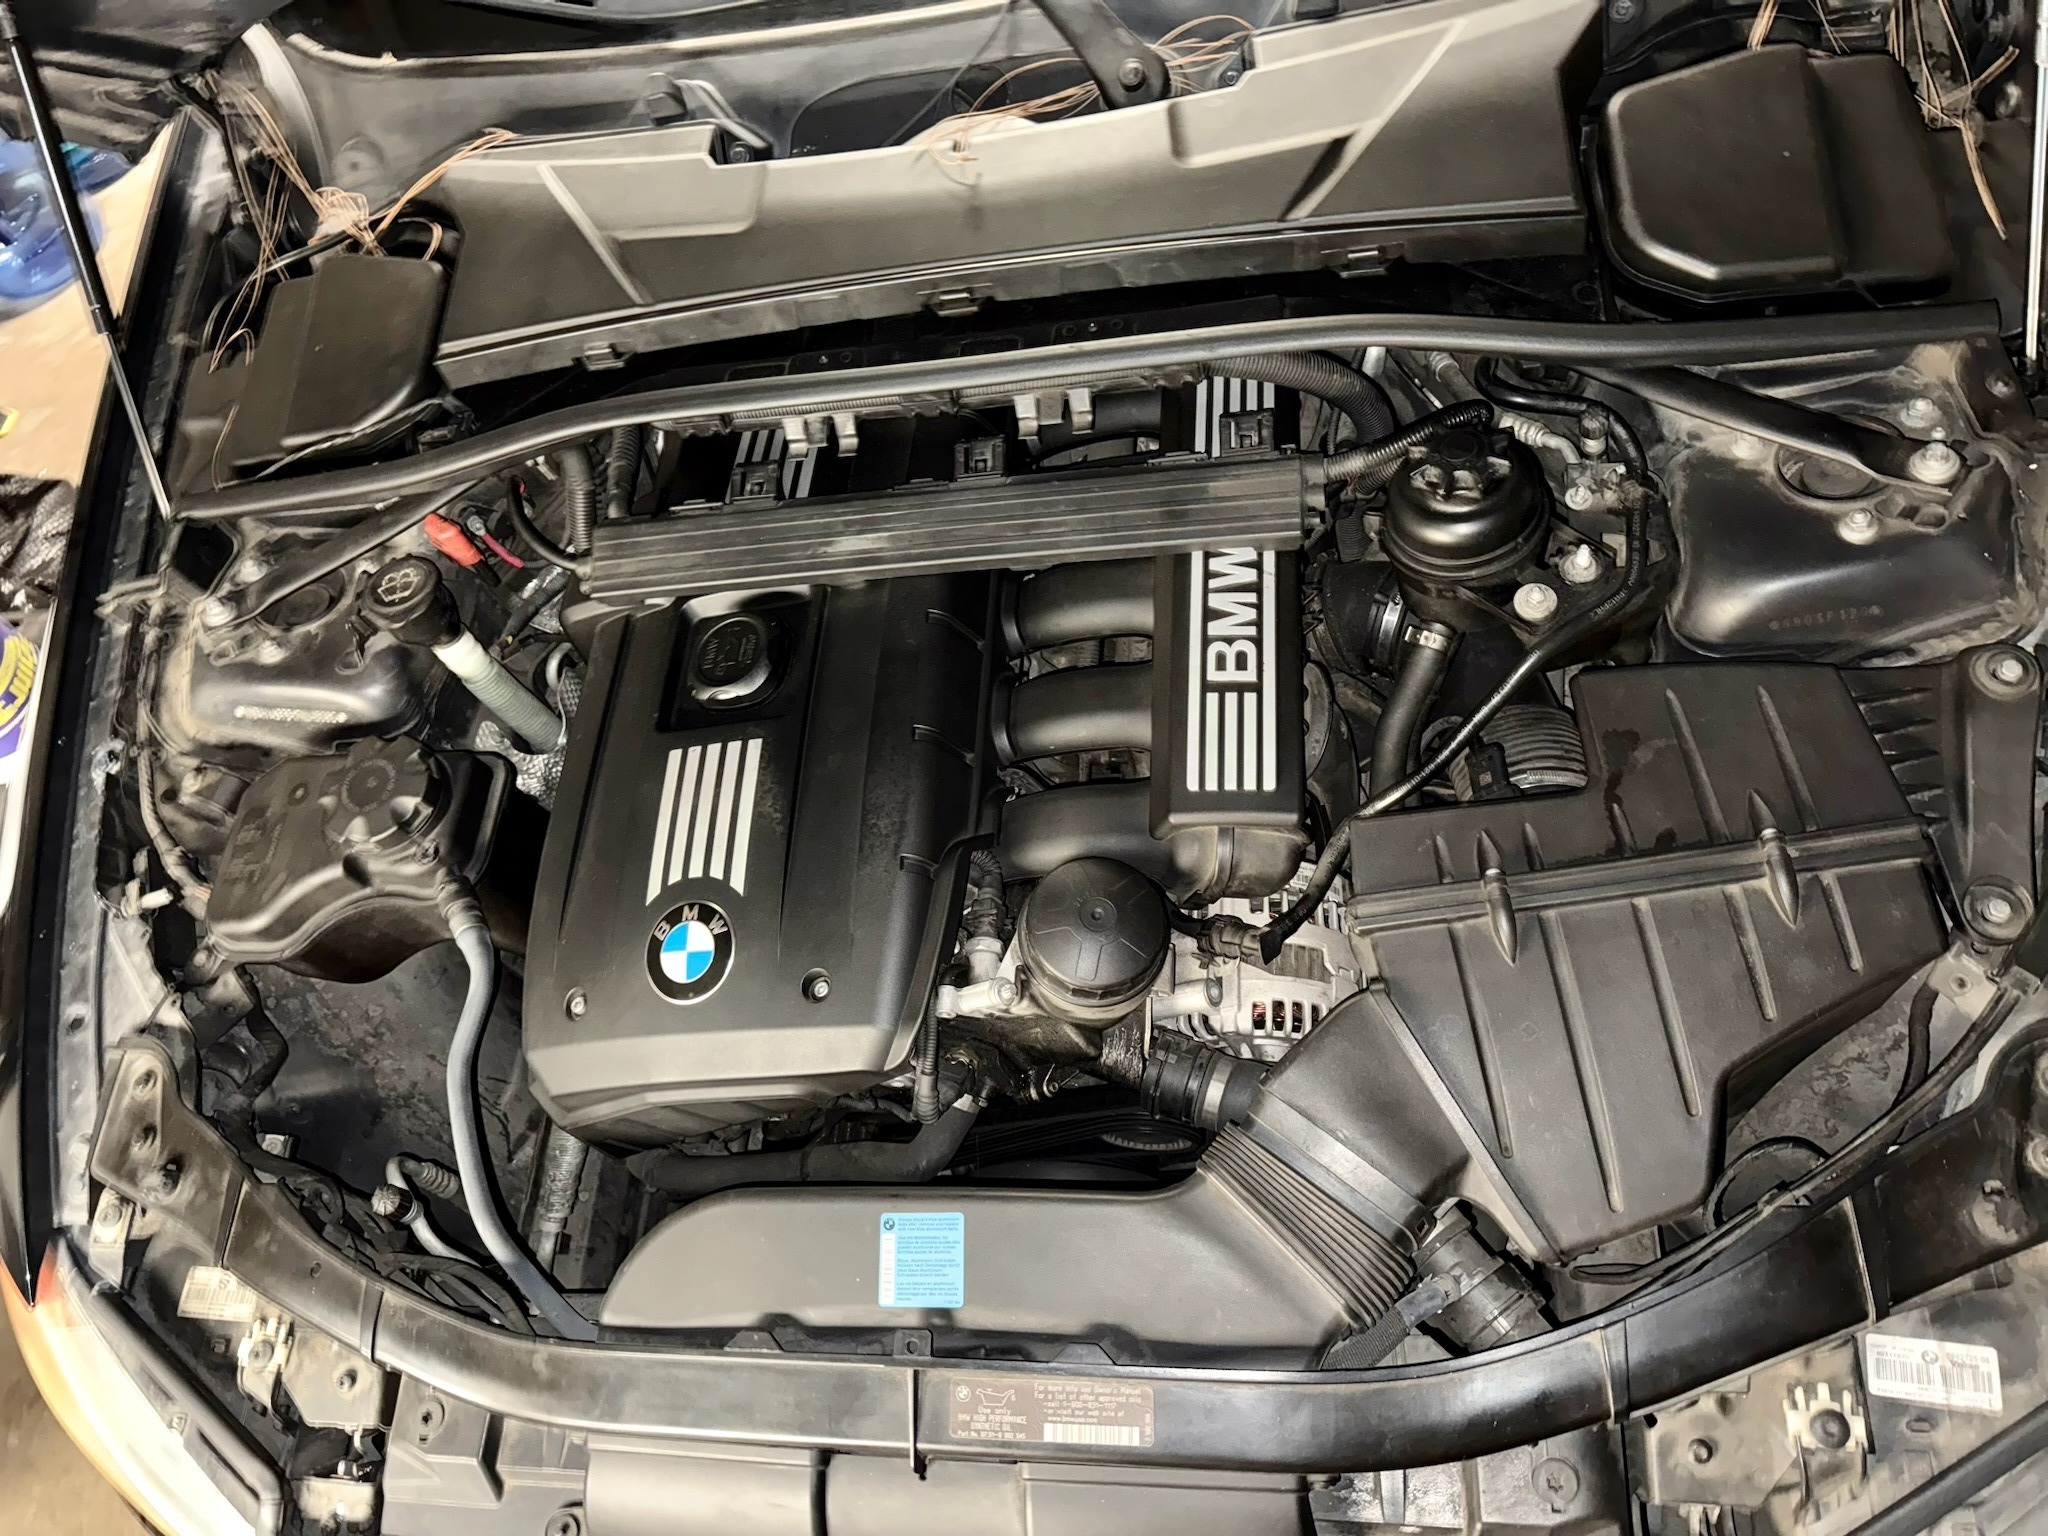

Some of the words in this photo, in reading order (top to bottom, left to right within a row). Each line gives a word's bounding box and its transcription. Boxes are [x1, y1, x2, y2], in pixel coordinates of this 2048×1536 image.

[1206, 547, 1258, 683] BMW
[653, 904, 728, 942] BMW
[1034, 1383, 1045, 1391] For
[1034, 1391, 1045, 1399] For
[1055, 1392, 1066, 1400] list
[1079, 1393, 1096, 1401] other
[1098, 1395, 1127, 1403] approved
[977, 1405, 991, 1414] Use
[995, 1406, 1011, 1416] only
[957, 1413, 971, 1421] BMW
[988, 1414, 1027, 1424] PERFORMANCE
[970, 1422, 1001, 1431] SYNTHETIC
[1002, 1423, 1012, 1432] OIL
